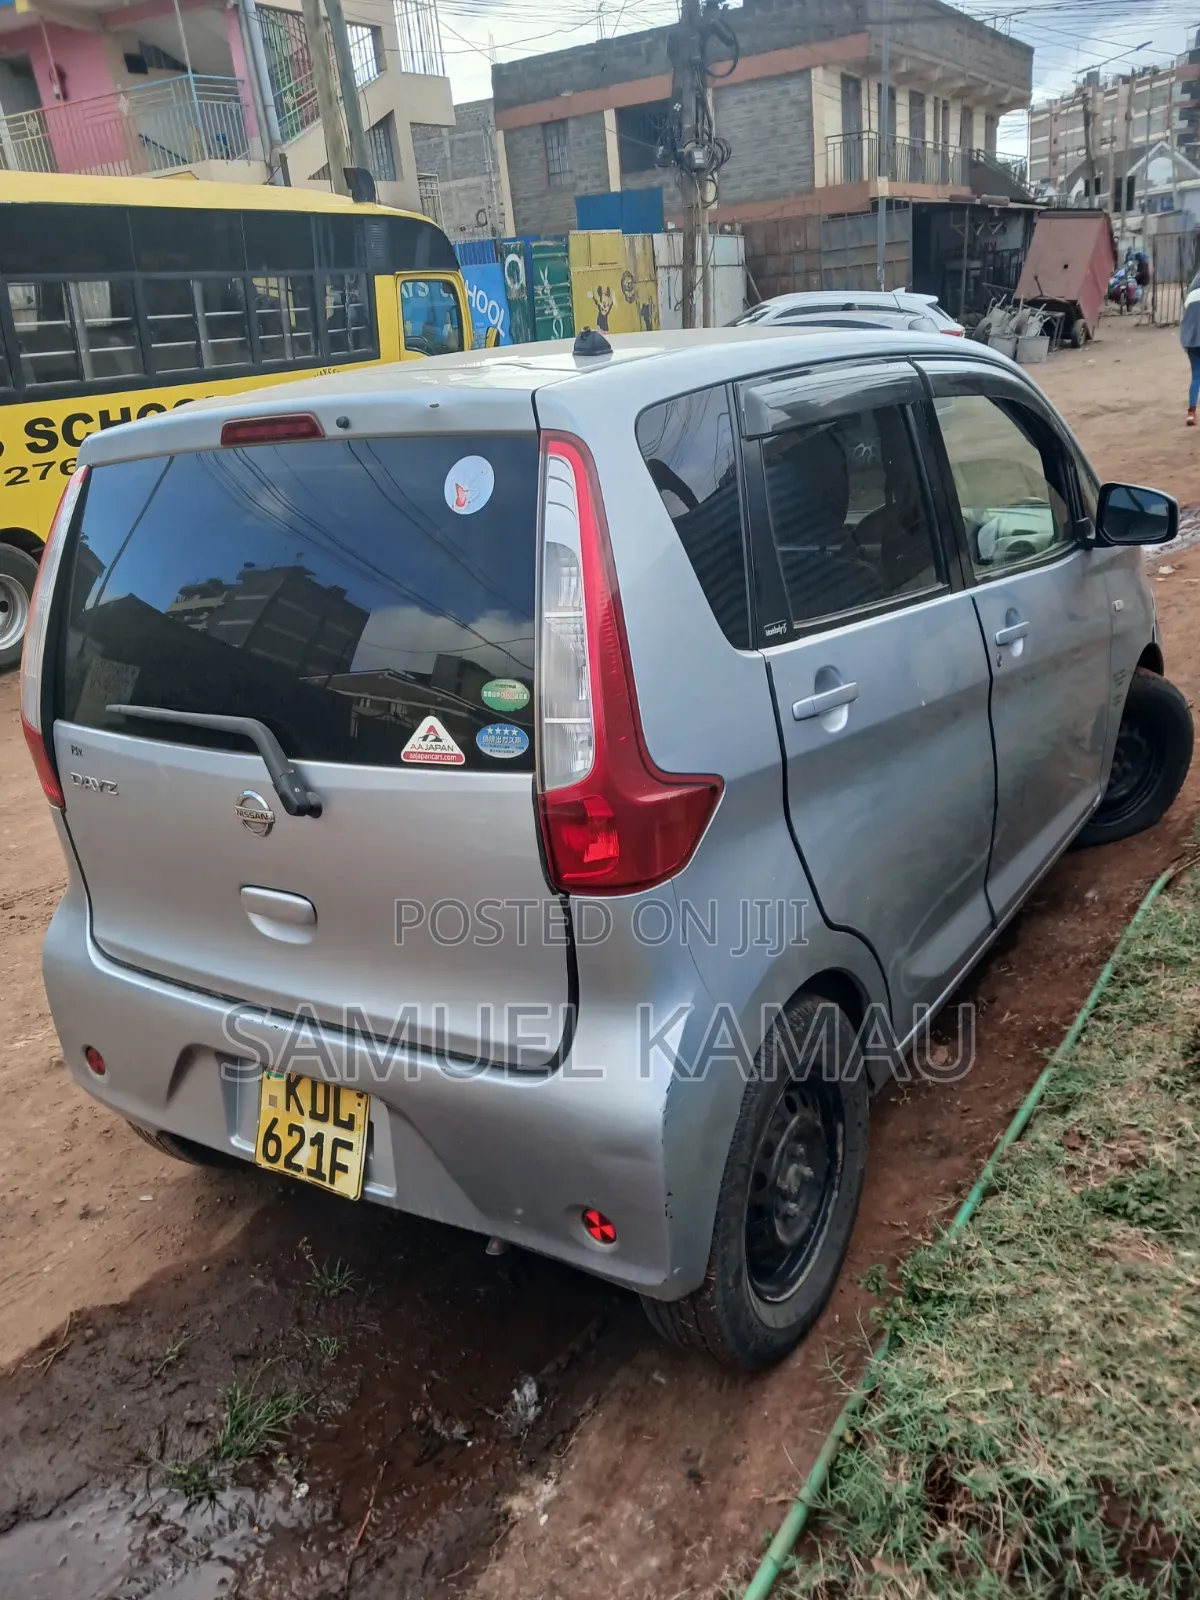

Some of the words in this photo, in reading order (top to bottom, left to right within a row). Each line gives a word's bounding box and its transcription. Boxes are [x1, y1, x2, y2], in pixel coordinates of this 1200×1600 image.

[409, 752, 457, 762] aajapancars.com
[425, 744, 454, 753] JAPAN
[70, 771, 119, 796] DAYZ
[236, 808, 269, 821] NISSAN
[285, 1072, 356, 1132] KDL
[261, 1116, 354, 1186] 621F
